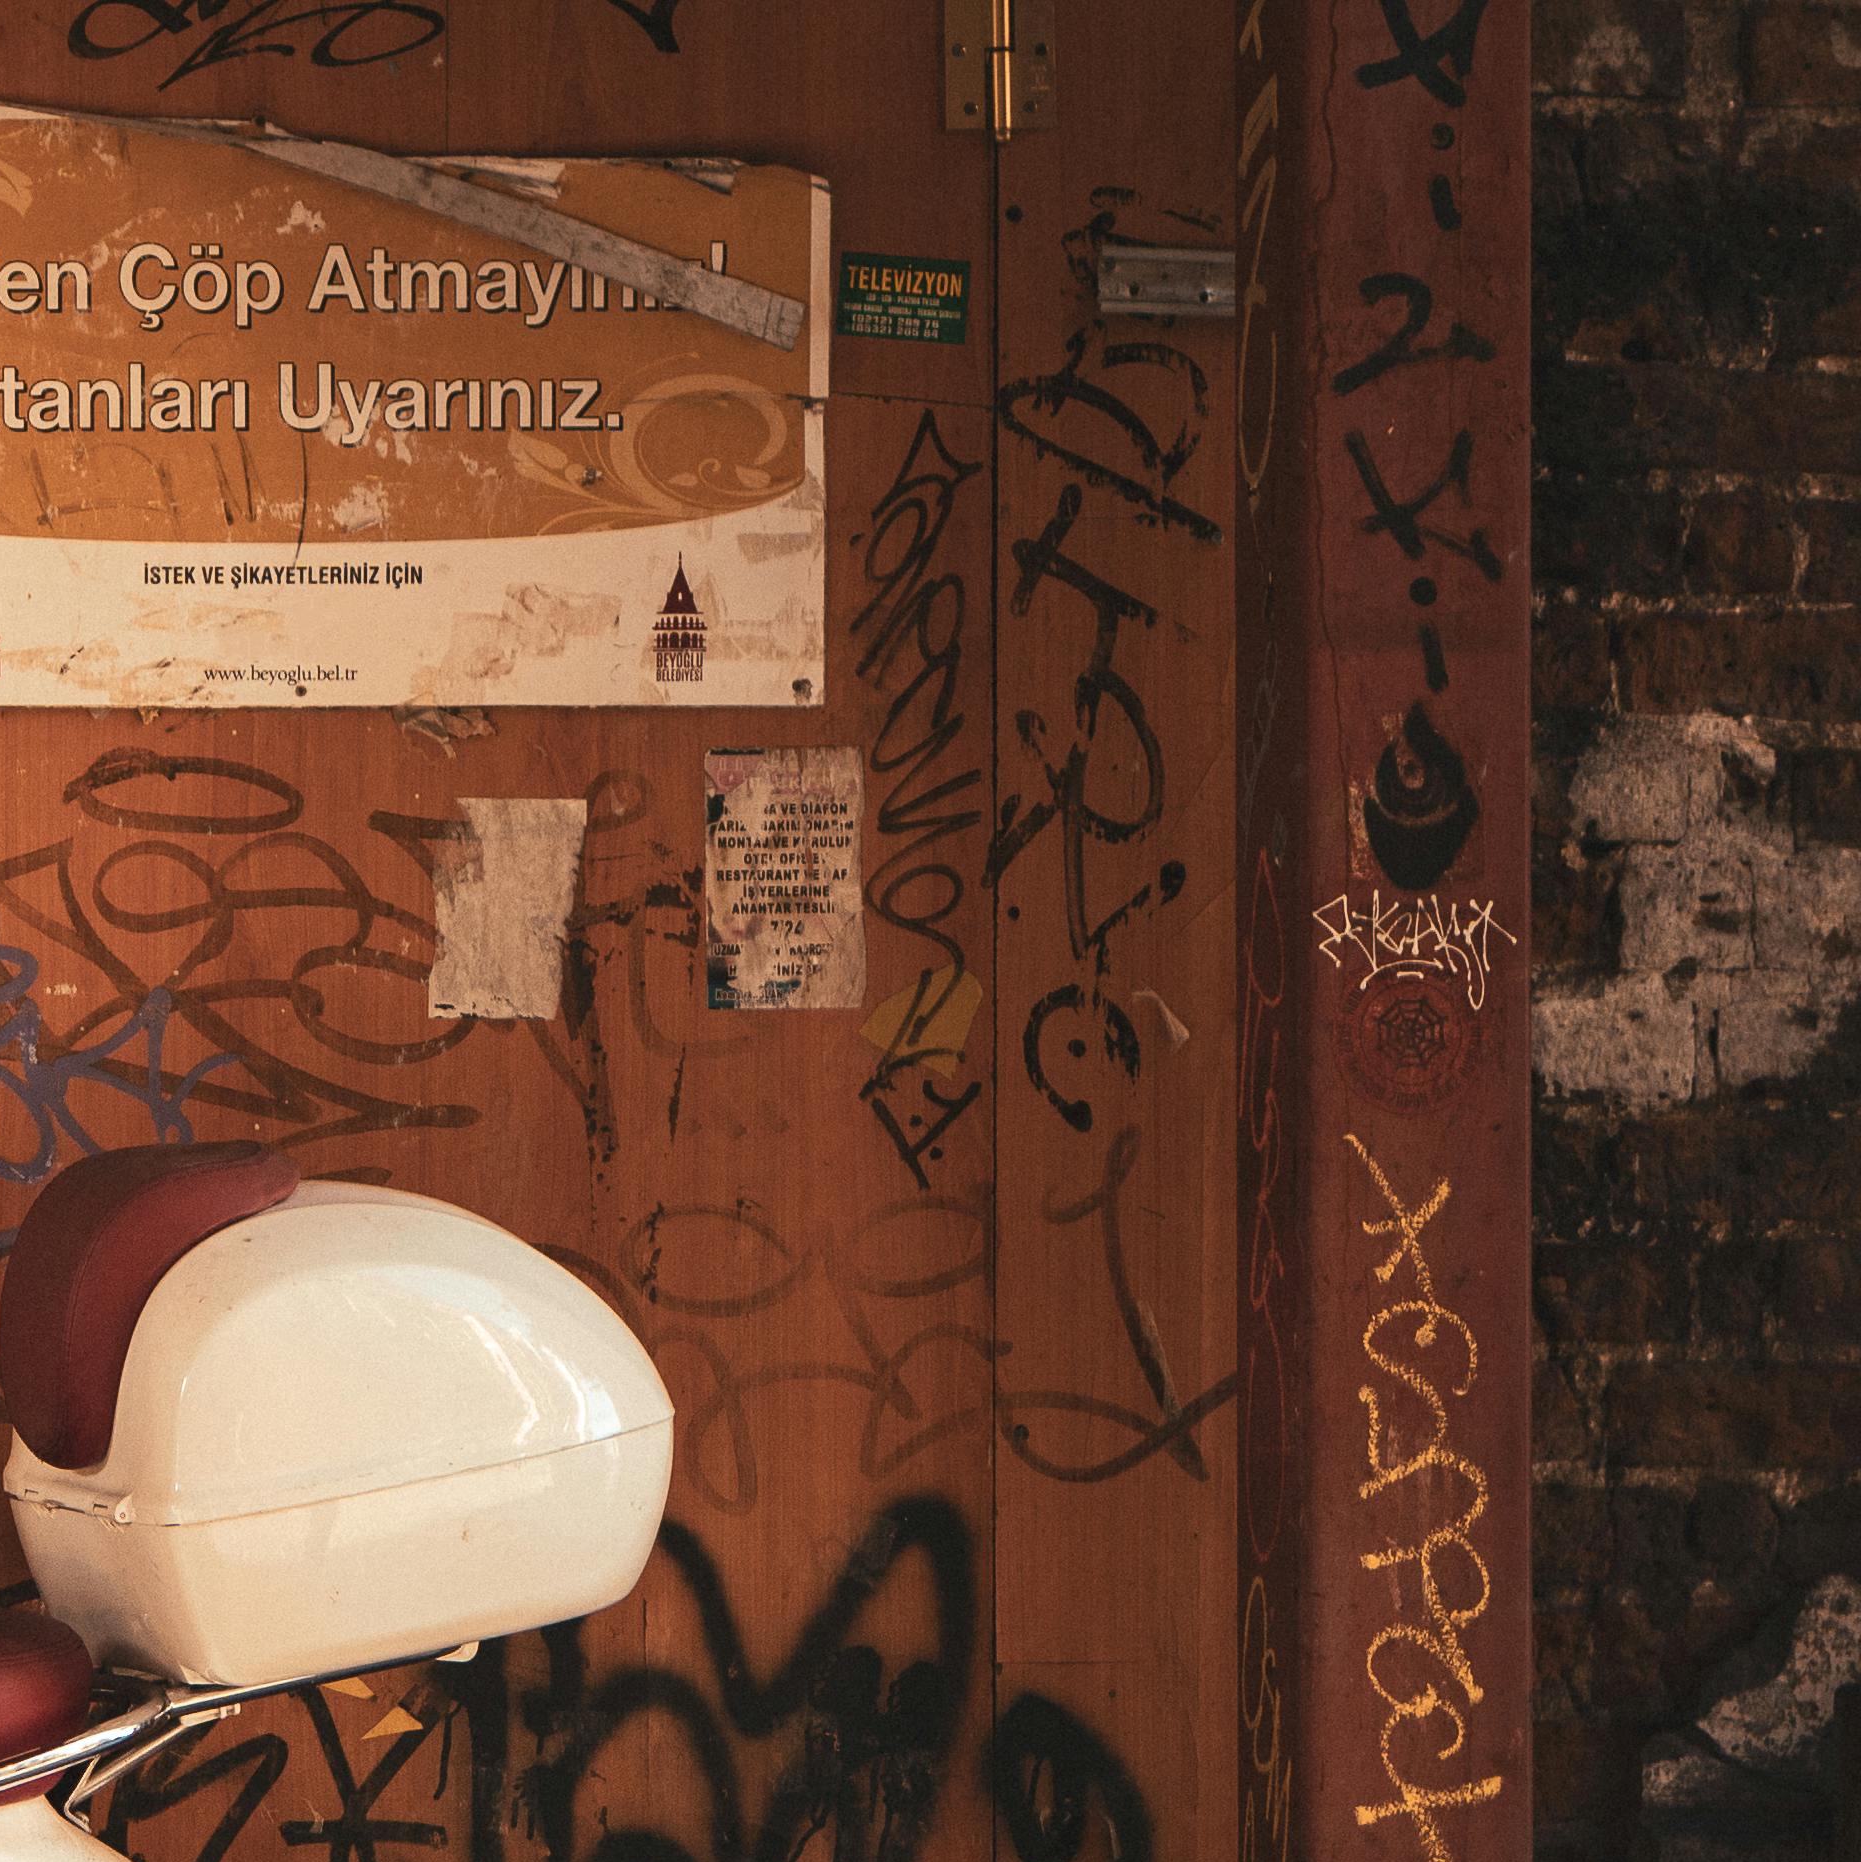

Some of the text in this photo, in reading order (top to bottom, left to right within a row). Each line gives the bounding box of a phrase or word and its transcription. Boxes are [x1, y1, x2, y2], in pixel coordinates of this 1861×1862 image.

[118, 243, 284, 330] Çöp
[847, 264, 964, 298] TELEVİZYON
[277, 361, 625, 447] Uyarınız.
[143, 562, 423, 589] İSTEK VE ŞİKAYETLERİNİZ İÇİN
[656, 649, 704, 668] BEYOĞLU
[203, 665, 358, 686] www.beyoglu.bel.tr
[716, 869, 800, 881] RESTAURANT
[731, 902, 792, 915] ANAHTAR
